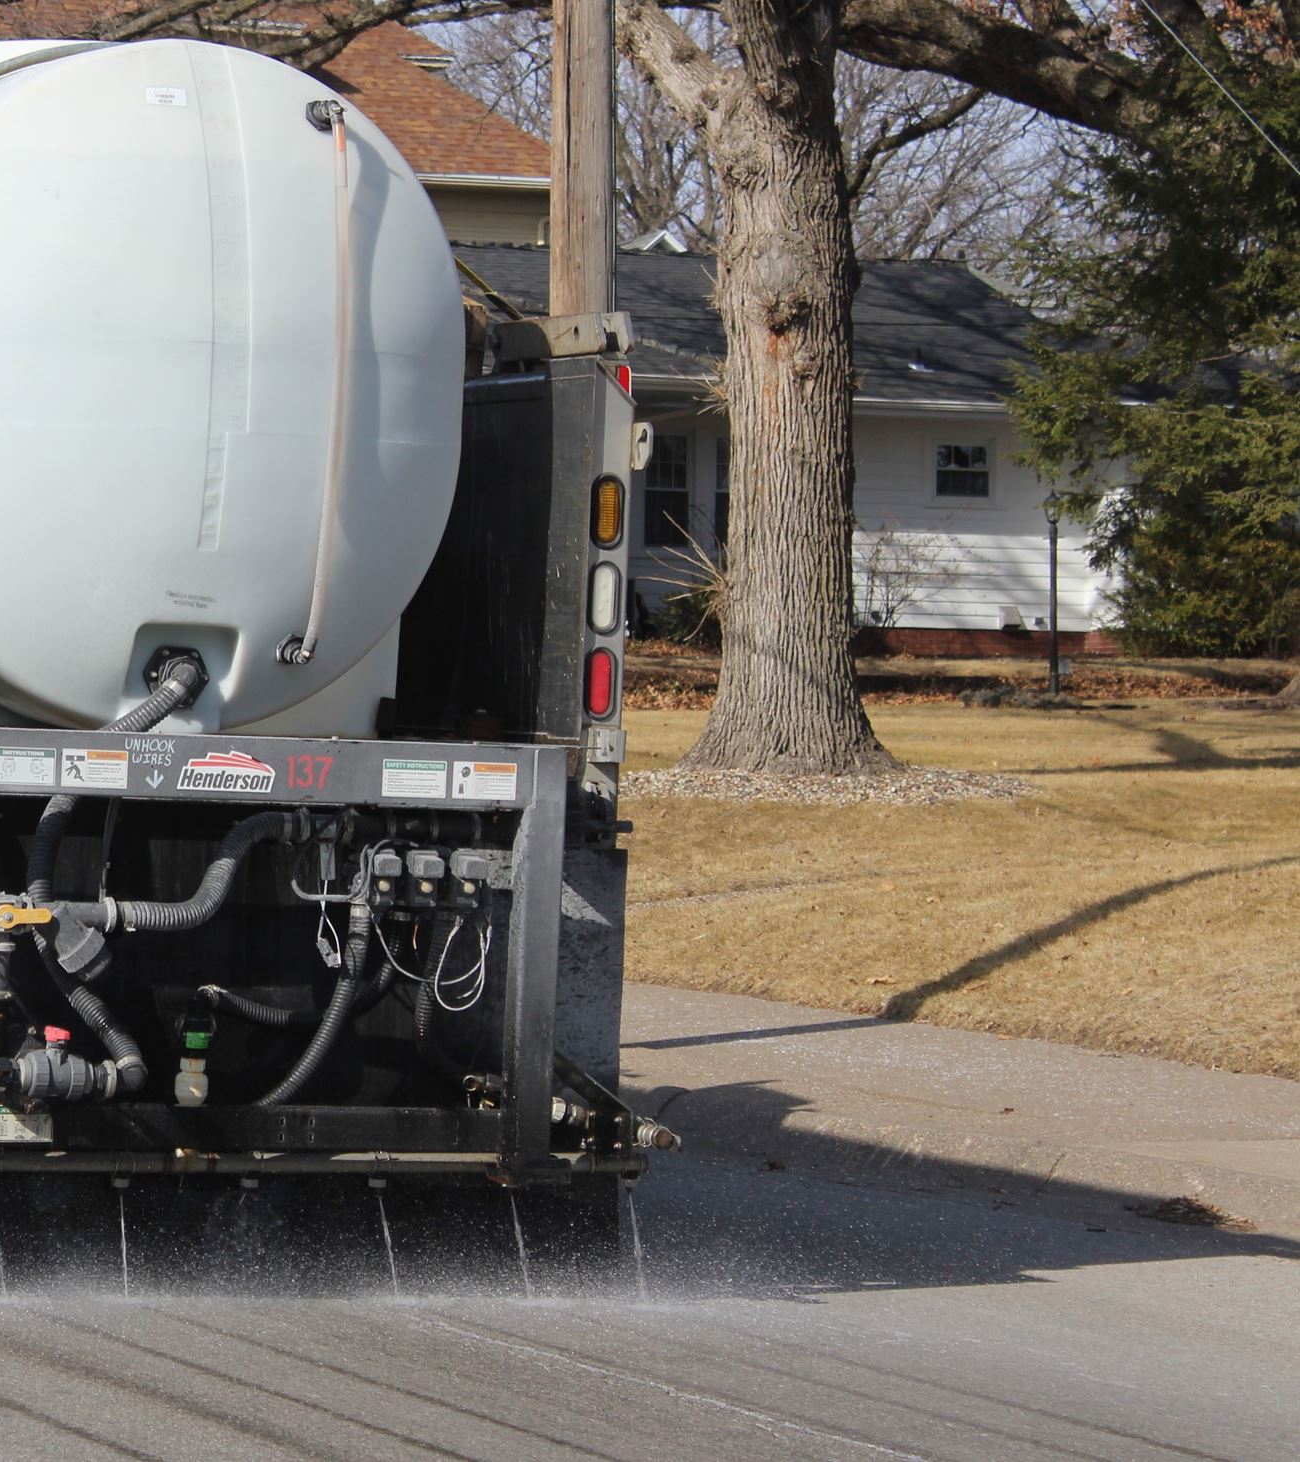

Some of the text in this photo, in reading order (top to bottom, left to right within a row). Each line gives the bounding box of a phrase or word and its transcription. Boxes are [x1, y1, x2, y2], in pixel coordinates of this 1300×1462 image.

[124, 738, 176, 753] UNHOOK
[2, 749, 45, 757] INSTRUCTIONS
[132, 753, 172, 767] WIRES
[288, 755, 333, 789] 137
[407, 762, 445, 770] INSTRUCTIONS
[180, 768, 272, 791] Henderson
